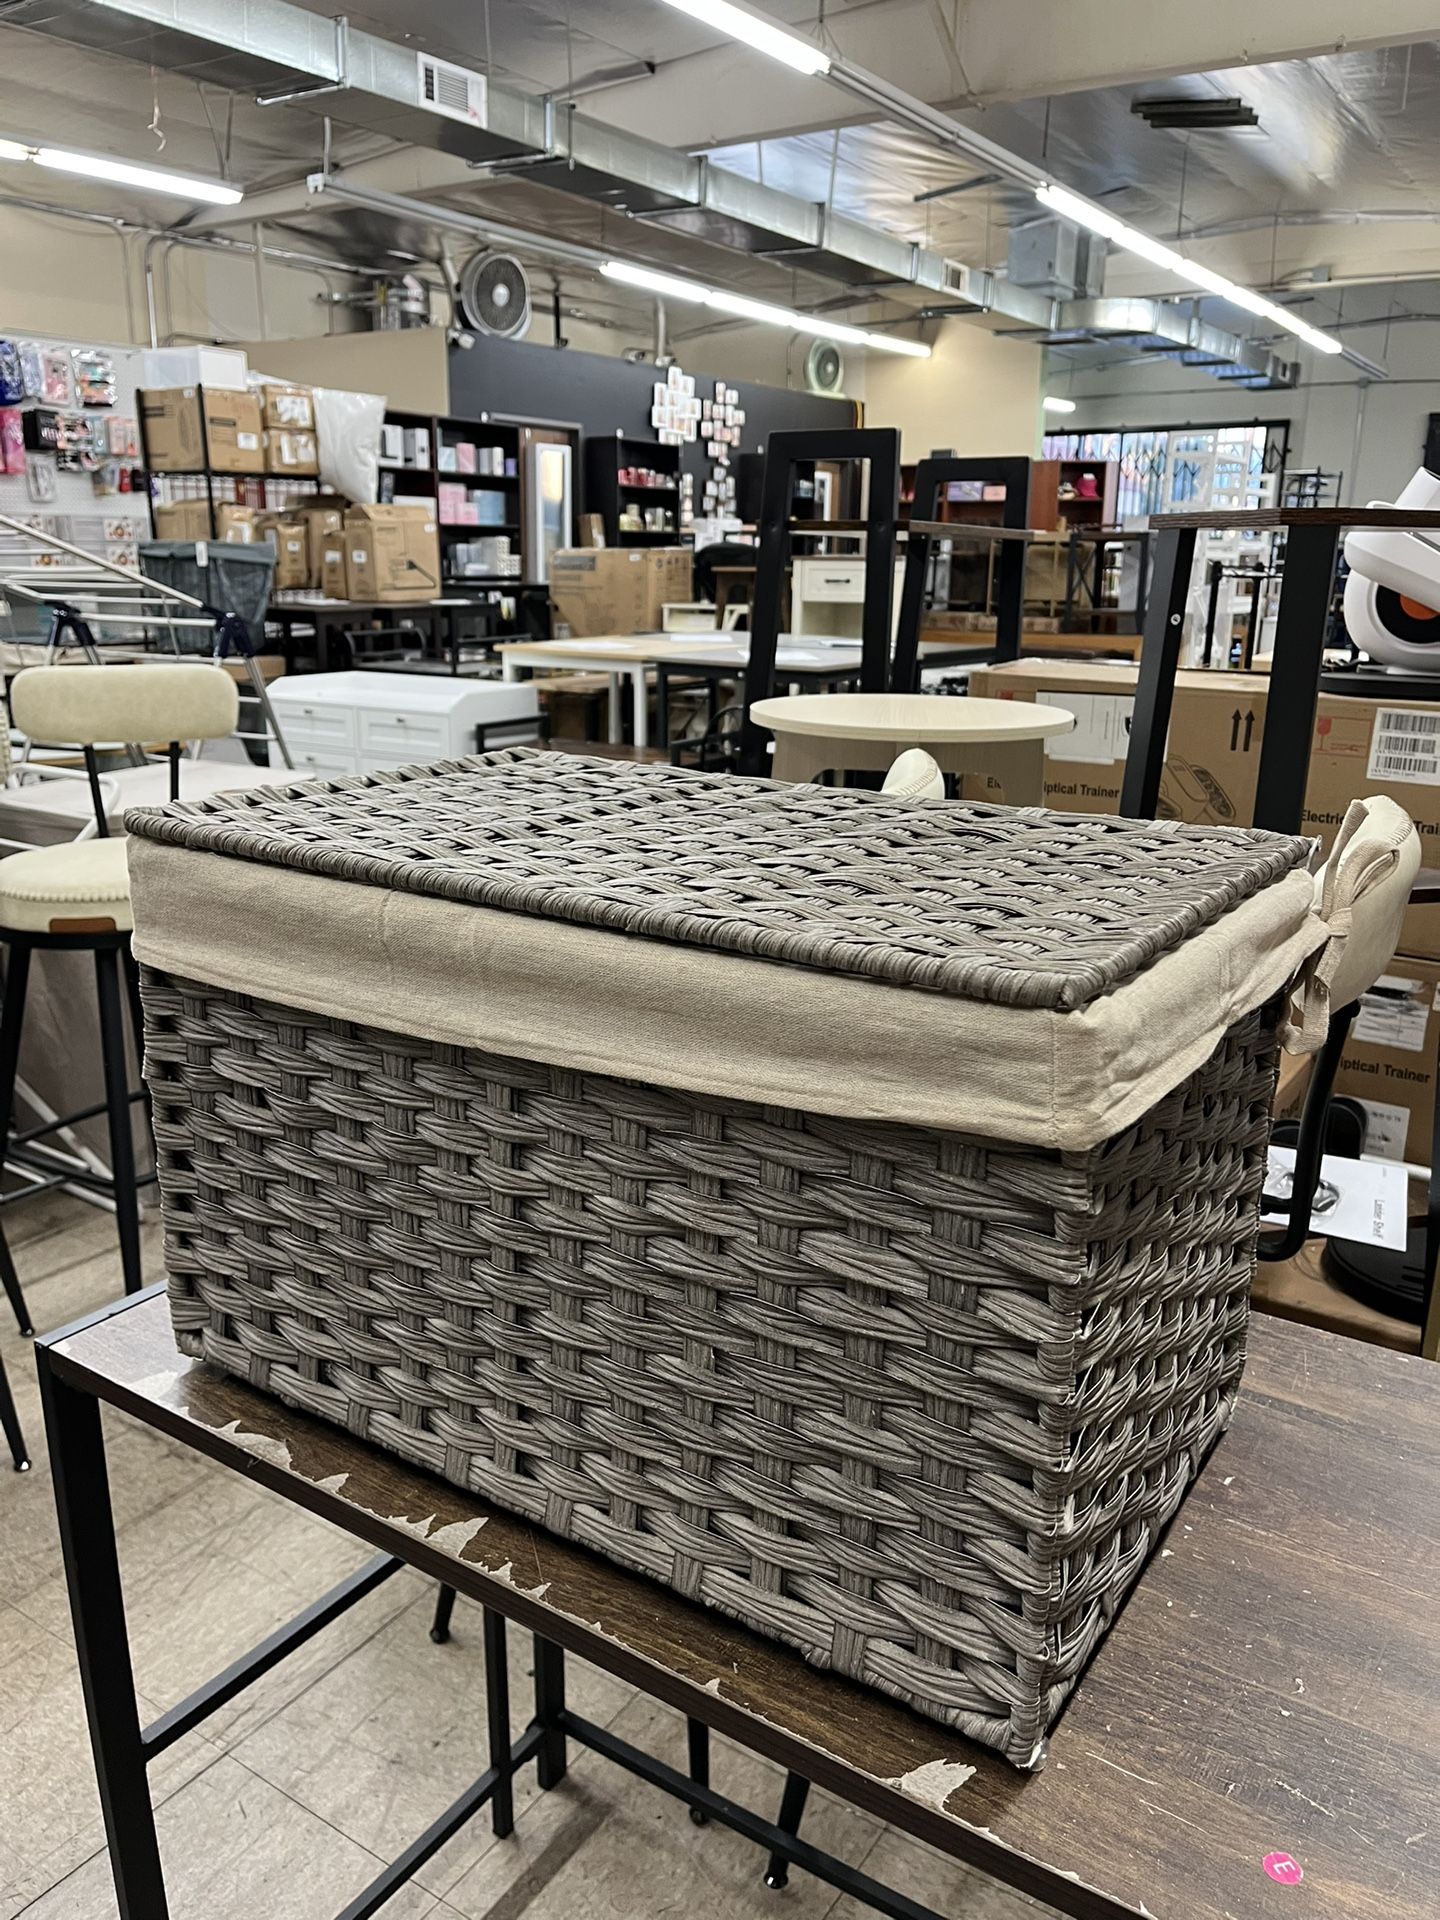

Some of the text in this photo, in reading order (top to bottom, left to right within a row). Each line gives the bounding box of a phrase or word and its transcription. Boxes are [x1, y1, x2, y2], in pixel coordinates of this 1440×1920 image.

[1043, 781, 1077, 795] iptical
[1080, 784, 1120, 798] Trainer
[1413, 820, 1440, 835] Trai
[1340, 1056, 1431, 1083] iptical Trainer
[1273, 1860, 1296, 1875] E
